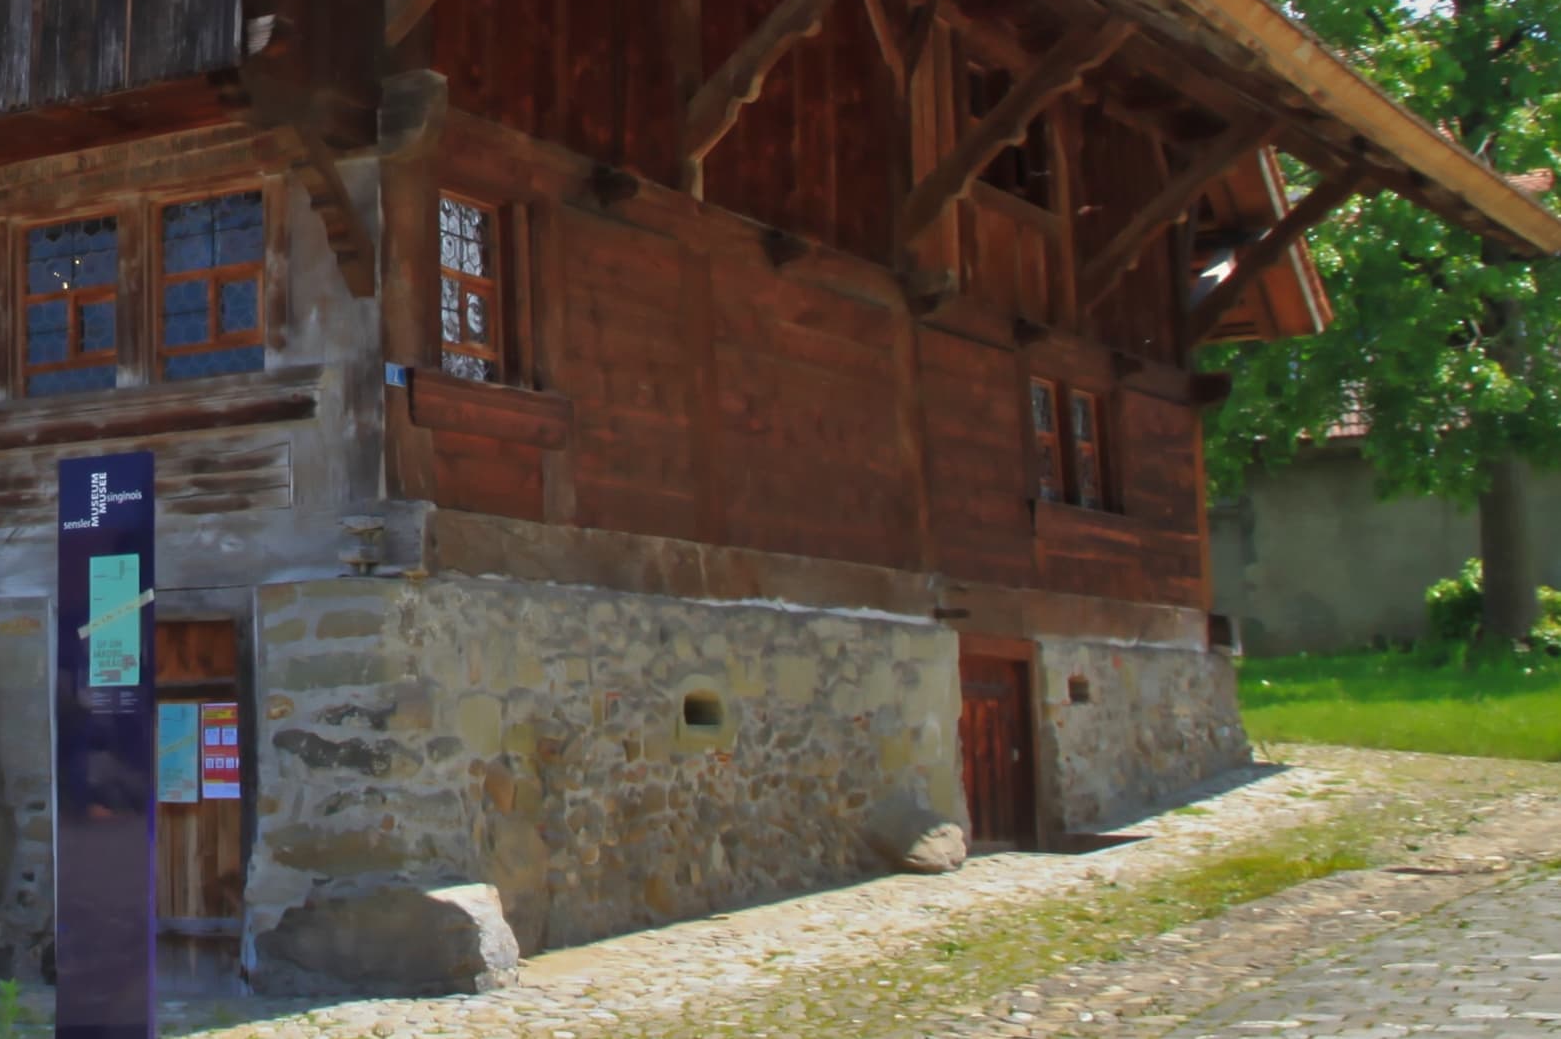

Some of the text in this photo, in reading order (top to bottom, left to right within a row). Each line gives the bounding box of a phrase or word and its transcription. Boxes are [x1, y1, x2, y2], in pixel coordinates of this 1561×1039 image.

[91, 472, 99, 527] MUSEUM
[106, 489, 142, 504] singinois
[63, 518, 91, 530] sensler
